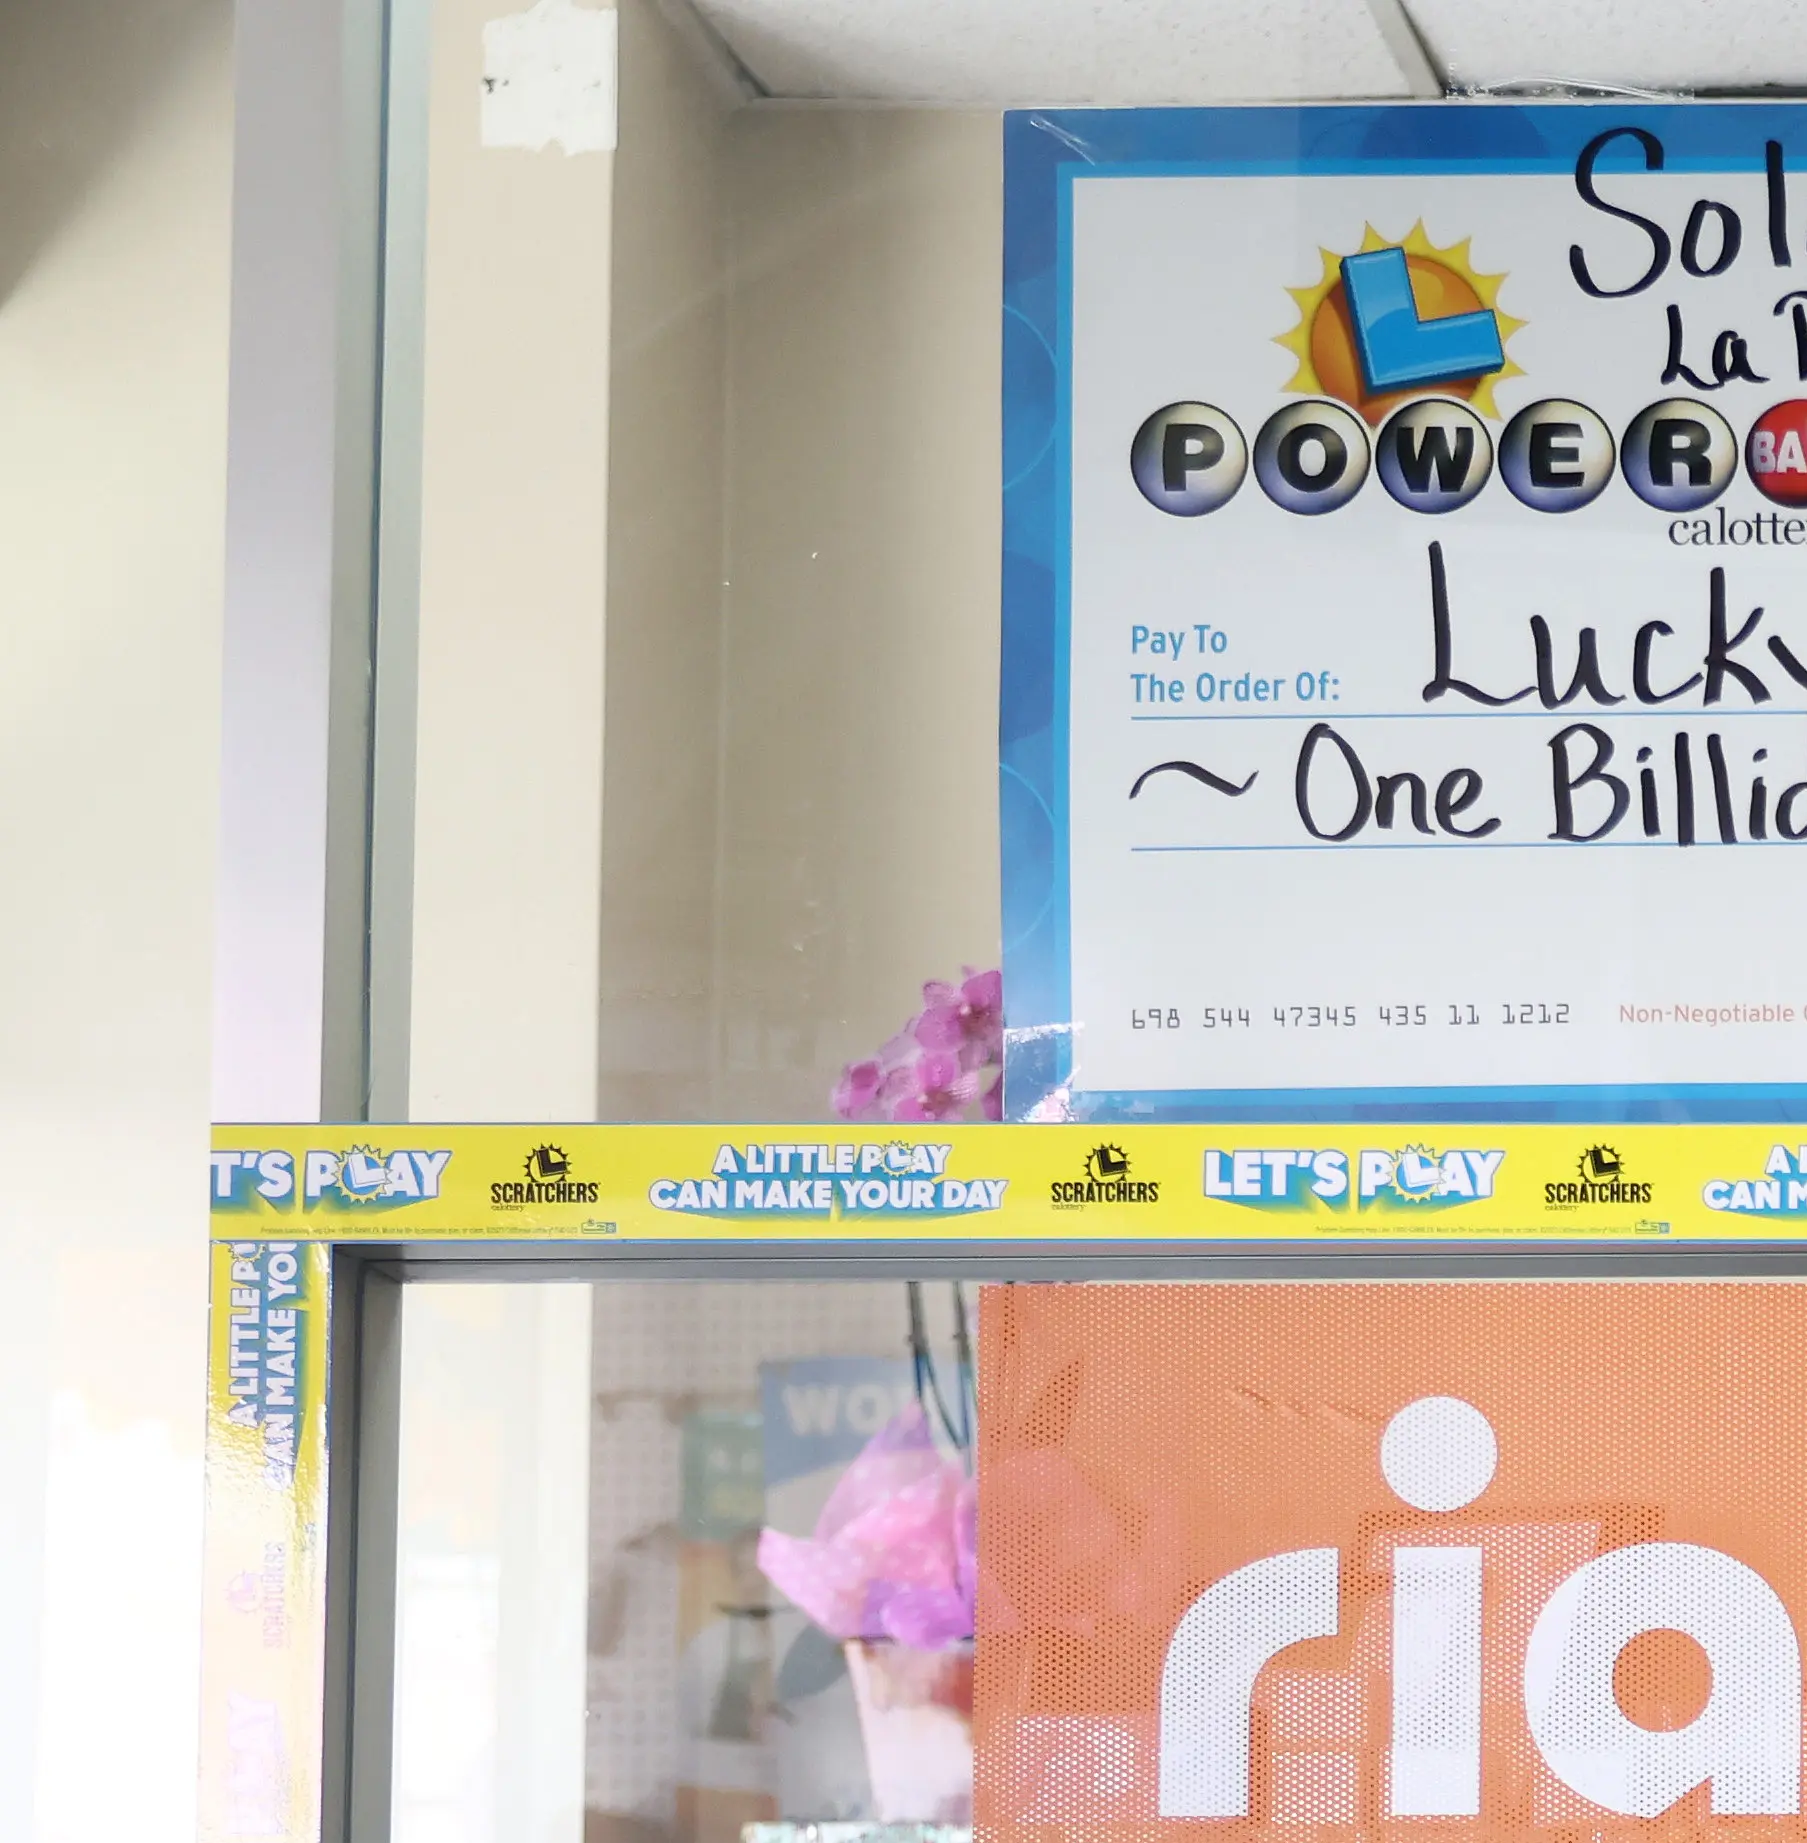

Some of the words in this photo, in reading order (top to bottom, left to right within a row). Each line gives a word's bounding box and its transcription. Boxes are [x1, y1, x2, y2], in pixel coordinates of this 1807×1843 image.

[1660, 303, 1769, 390] La
[1130, 625, 1178, 664] Pay
[1193, 626, 1228, 655] To
[1130, 671, 1184, 703] The
[1194, 671, 1286, 703] Order
[1295, 671, 1340, 702] Of:
[1296, 722, 1503, 844] One
[1132, 1008, 1181, 1029] 698
[1203, 1008, 1250, 1028] 544
[1273, 1006, 1356, 1027] 47345
[1379, 1005, 1427, 1026] 435
[1448, 1004, 1480, 1026] 11
[1502, 1003, 1570, 1025] 1212
[1619, 1003, 1794, 1026] Non-Negotiable
[1202, 1148, 1347, 1199] LET'S
[1360, 1142, 1507, 1202] PLAY
[1764, 1144, 1790, 1176] A
[1544, 1184, 1653, 1204] SCRATCHERS
[1703, 1178, 1774, 1212] CAN
[1158, 1395, 1802, 1818] ria
